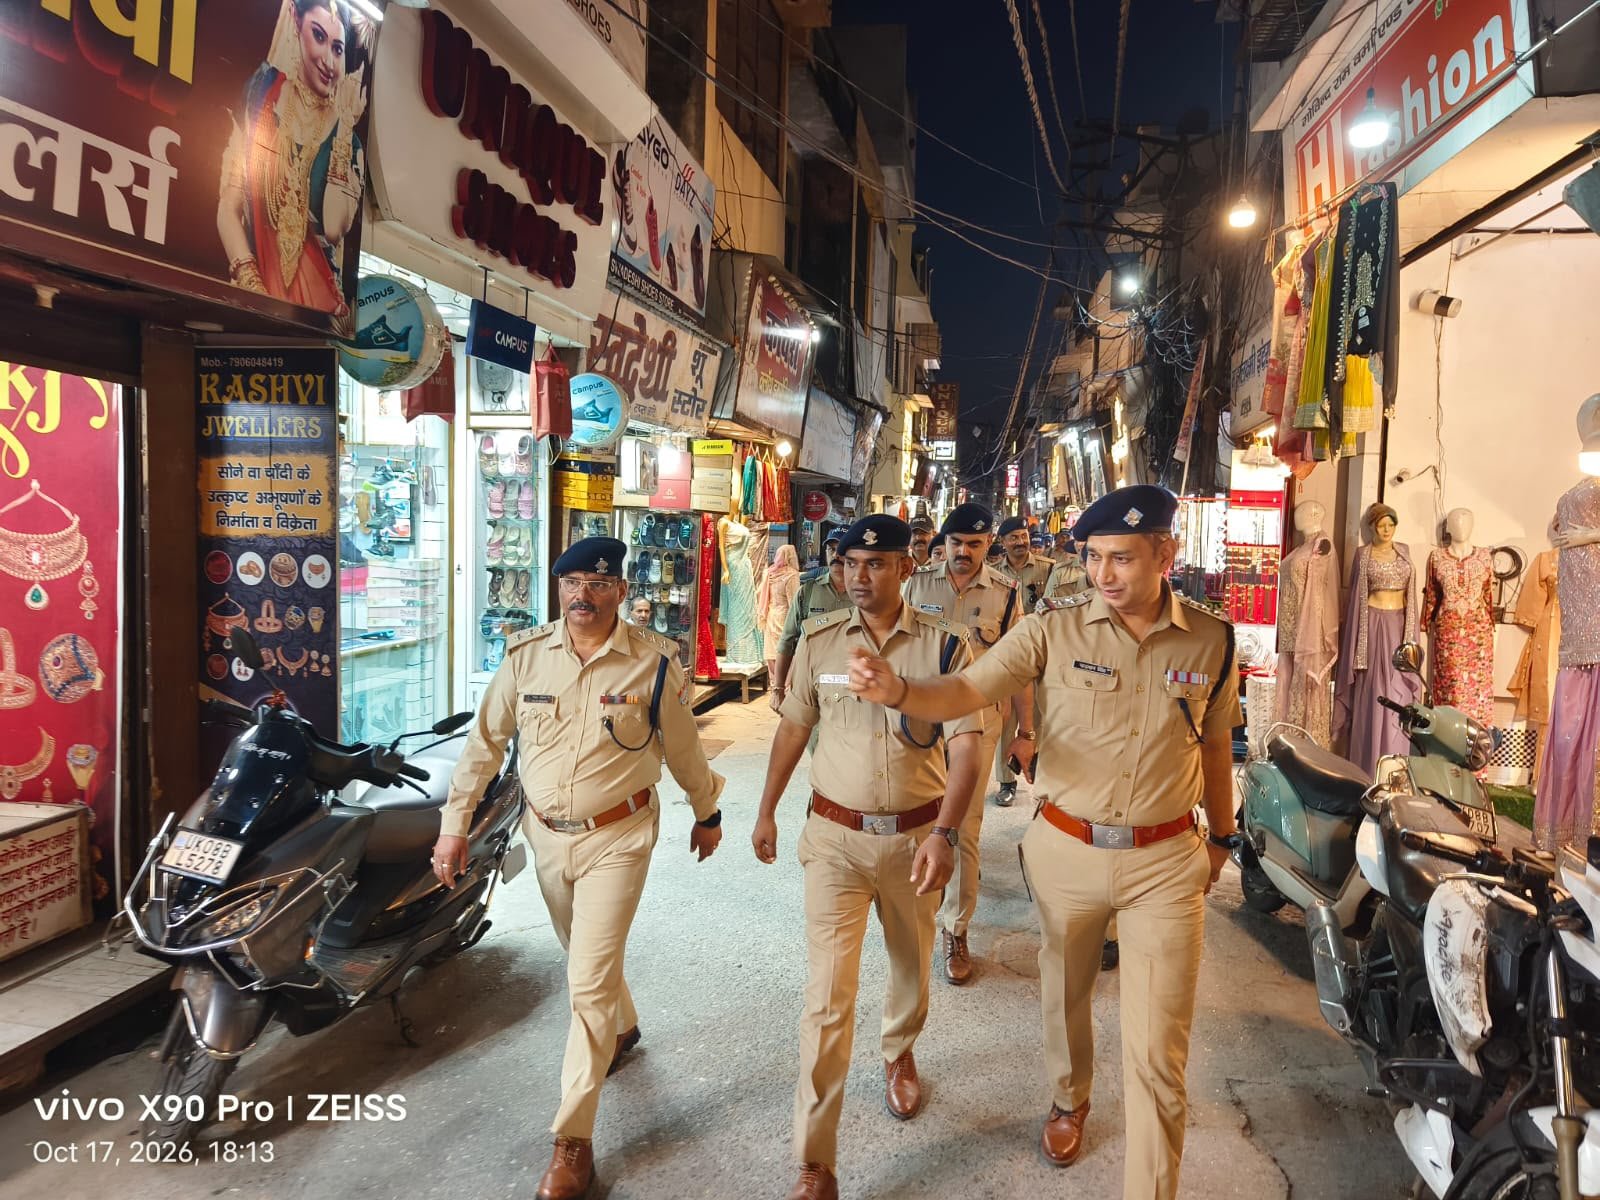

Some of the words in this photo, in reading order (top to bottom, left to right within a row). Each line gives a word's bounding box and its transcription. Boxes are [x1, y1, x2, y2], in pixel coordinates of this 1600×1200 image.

[1332, 65, 1351, 90] राम
[421, 8, 606, 226] UNIQUE
[451, 167, 578, 289] SHOES
[358, 285, 395, 308] ampus
[640, 280, 659, 302] SHOES
[495, 333, 529, 355] CAMPUS
[691, 349, 708, 389] शू
[200, 373, 326, 405] KASHVI
[572, 380, 604, 396] campus
[671, 387, 708, 419] स्टोर
[202, 415, 321, 438] JWELLERS
[217, 463, 244, 479] सोने
[248, 467, 261, 479] वा
[296, 464, 311, 480] के
[208, 490, 249, 507] उत्कृष्ट
[308, 489, 322, 505] के
[216, 510, 259, 528] निर्माता
[263, 517, 273, 529] व
[276, 512, 318, 531] विक्रेता
